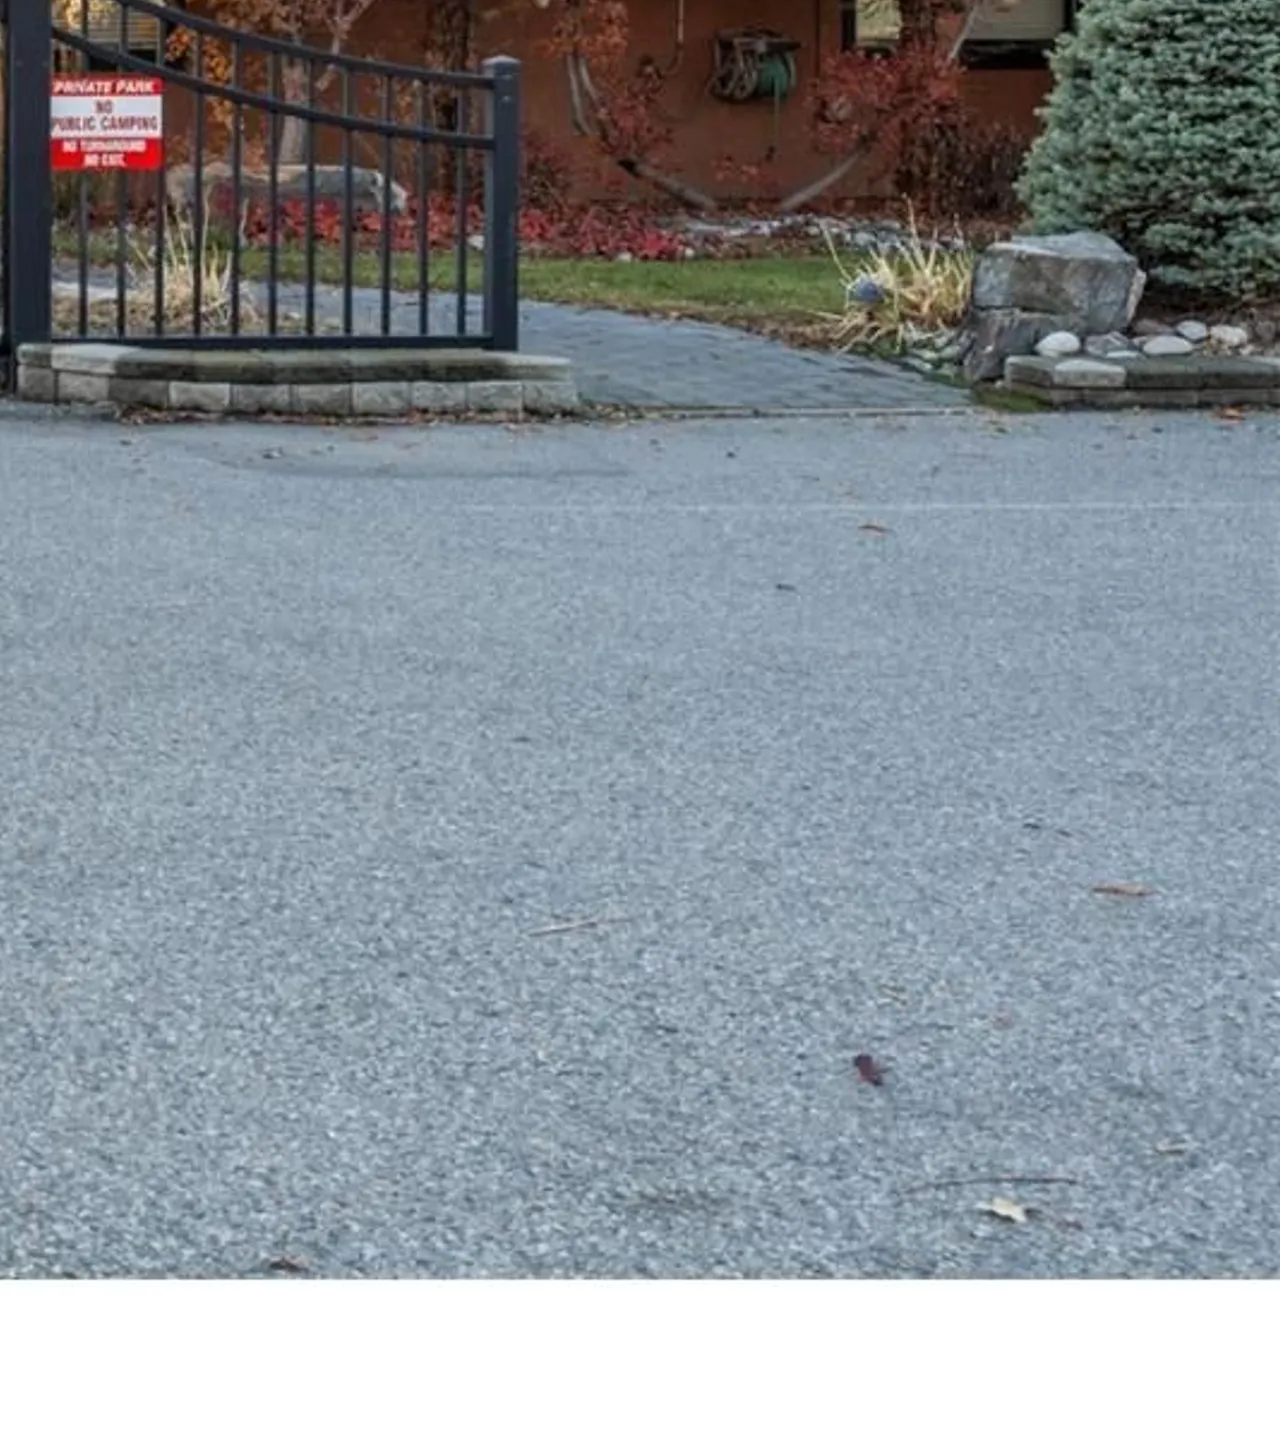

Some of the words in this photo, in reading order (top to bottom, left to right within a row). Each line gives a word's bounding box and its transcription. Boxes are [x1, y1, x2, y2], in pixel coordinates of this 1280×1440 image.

[52, 80, 114, 93] PRIVATE
[115, 80, 154, 93] PARK
[95, 100, 113, 113] NO
[51, 117, 96, 130] PUBLIC
[100, 117, 158, 131] CAMPING
